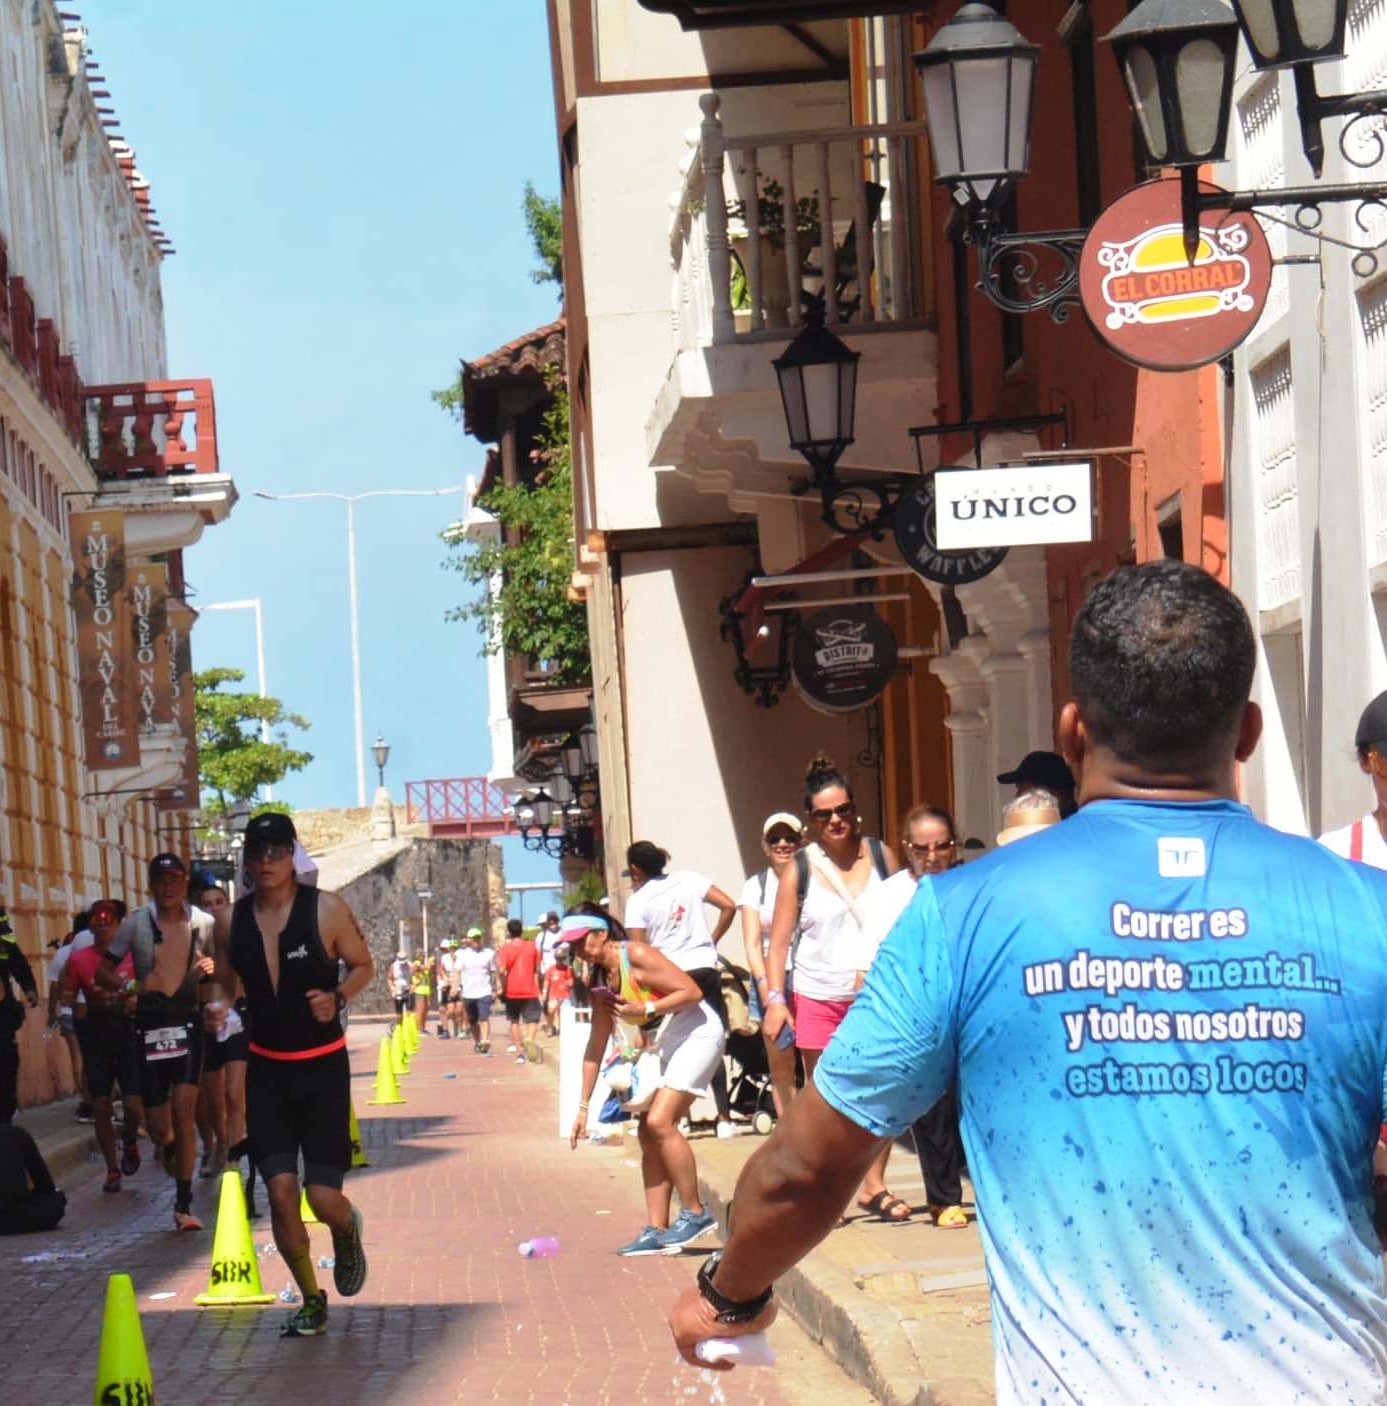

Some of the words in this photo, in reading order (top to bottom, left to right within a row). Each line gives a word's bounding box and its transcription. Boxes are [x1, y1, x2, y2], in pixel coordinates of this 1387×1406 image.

[1112, 276, 1145, 301] EL
[1144, 263, 1242, 296] CORRAL
[949, 494, 1077, 521] ÚNICO
[86, 535, 112, 625] MUSEO
[132, 586, 154, 664] MUSEO
[95, 631, 118, 722] NAVAL
[1111, 902, 1206, 940] Correr
[1209, 908, 1247, 937] es
[1024, 960, 1064, 996] un
[1068, 951, 1183, 995] deporte
[1188, 955, 1340, 993] mental...
[1064, 1012, 1084, 1051] y
[1088, 1005, 1170, 1041] todos
[1176, 1005, 1303, 1041] nosotros
[1067, 1058, 1212, 1094] estamos
